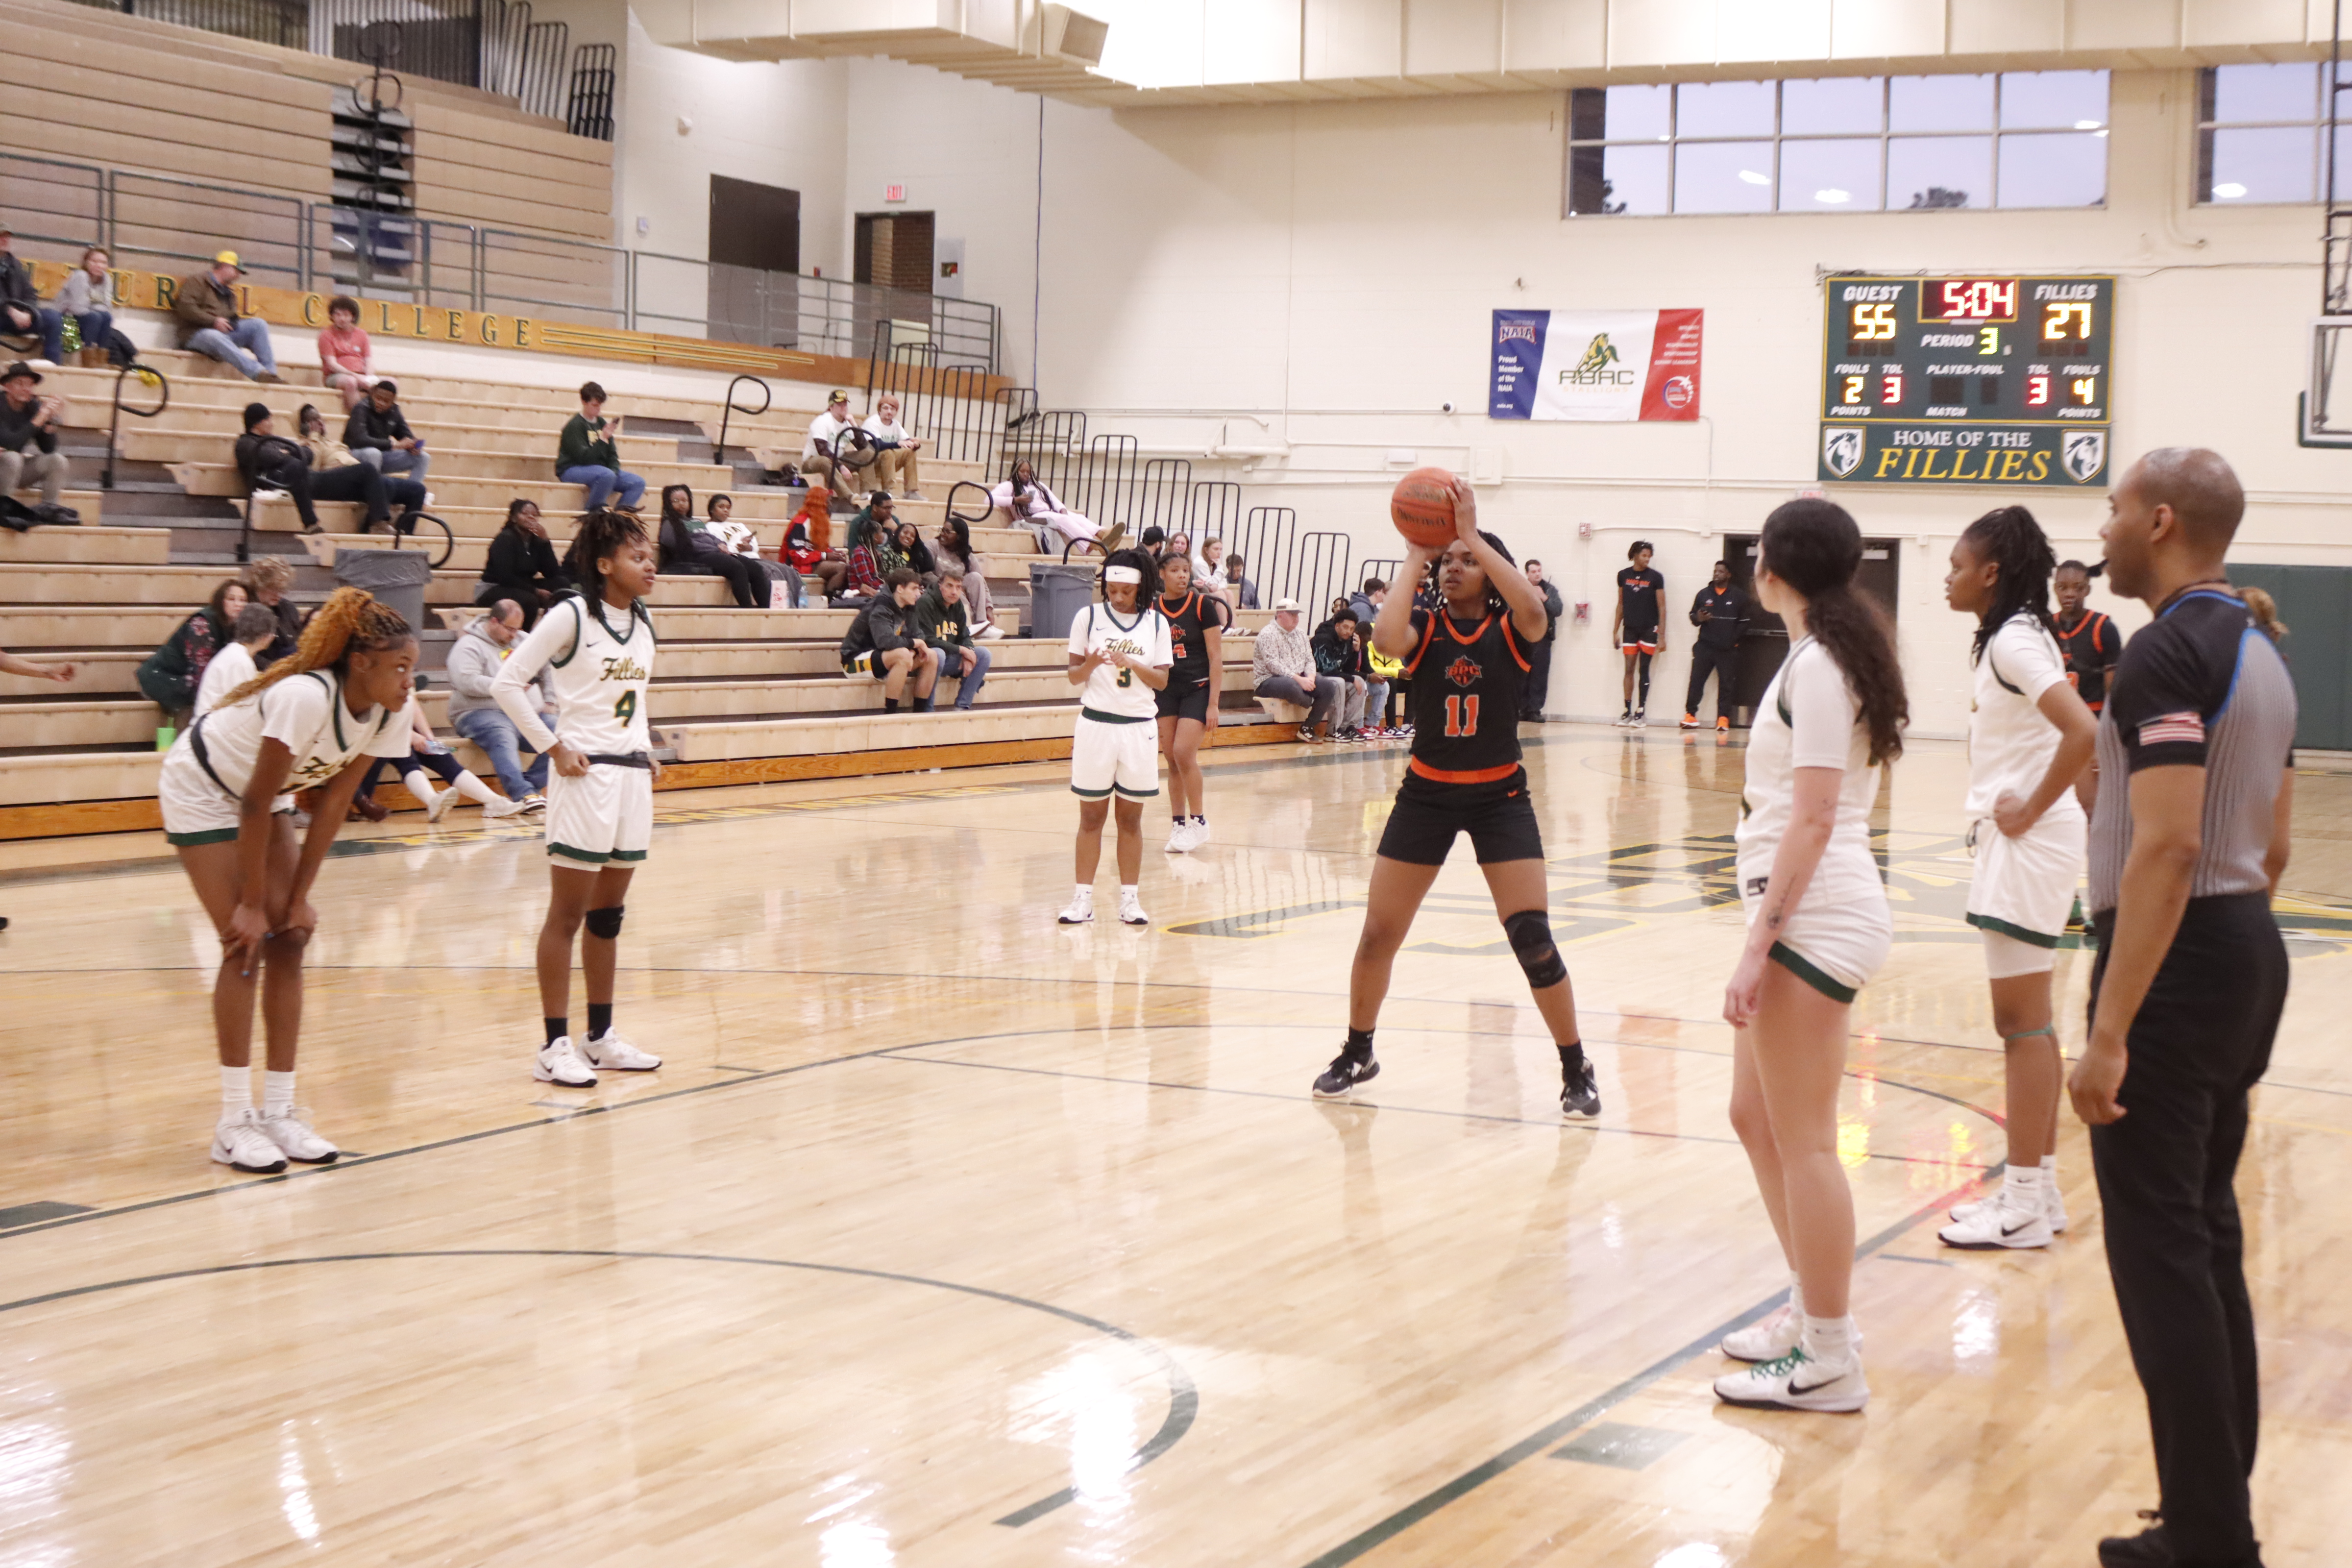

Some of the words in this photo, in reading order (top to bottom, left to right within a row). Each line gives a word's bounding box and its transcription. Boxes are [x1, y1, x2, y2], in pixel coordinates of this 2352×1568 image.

[887, 185, 903, 200] EXIT
[1843, 286, 1903, 301] GUEST
[1942, 281, 2014, 317] 5:04
[2034, 284, 2098, 300] FILLIES
[301, 292, 530, 349] CLLEGE
[1853, 304, 1896, 340] 55
[2043, 303, 2091, 339] 27
[1499, 326, 1536, 343] NAIA
[1920, 334, 1975, 347] PERIOD
[1978, 327, 1999, 355] 3
[1558, 370, 1634, 385] ABAC
[1834, 364, 1870, 374] FOULS
[1882, 364, 1904, 374] TOL
[2028, 365, 2050, 375] TOL
[2062, 365, 2101, 375] FOULS
[1844, 376, 1864, 403] 2
[1882, 376, 1902, 403] 3
[2028, 376, 2048, 404] 3
[2073, 377, 2094, 405] 4
[1830, 406, 1871, 416] POINTS
[1926, 406, 1968, 417] MATCH
[2058, 407, 2102, 418] POINTS
[1893, 430, 1952, 446] HOME
[1956, 431, 1984, 447] OF
[1986, 431, 2032, 447] THE
[1874, 448, 2052, 481] FILLIES
[1104, 638, 1145, 656] Fillies
[1448, 665, 1480, 676] BPC
[614, 689, 637, 728] 4
[1445, 694, 1479, 737] 11
